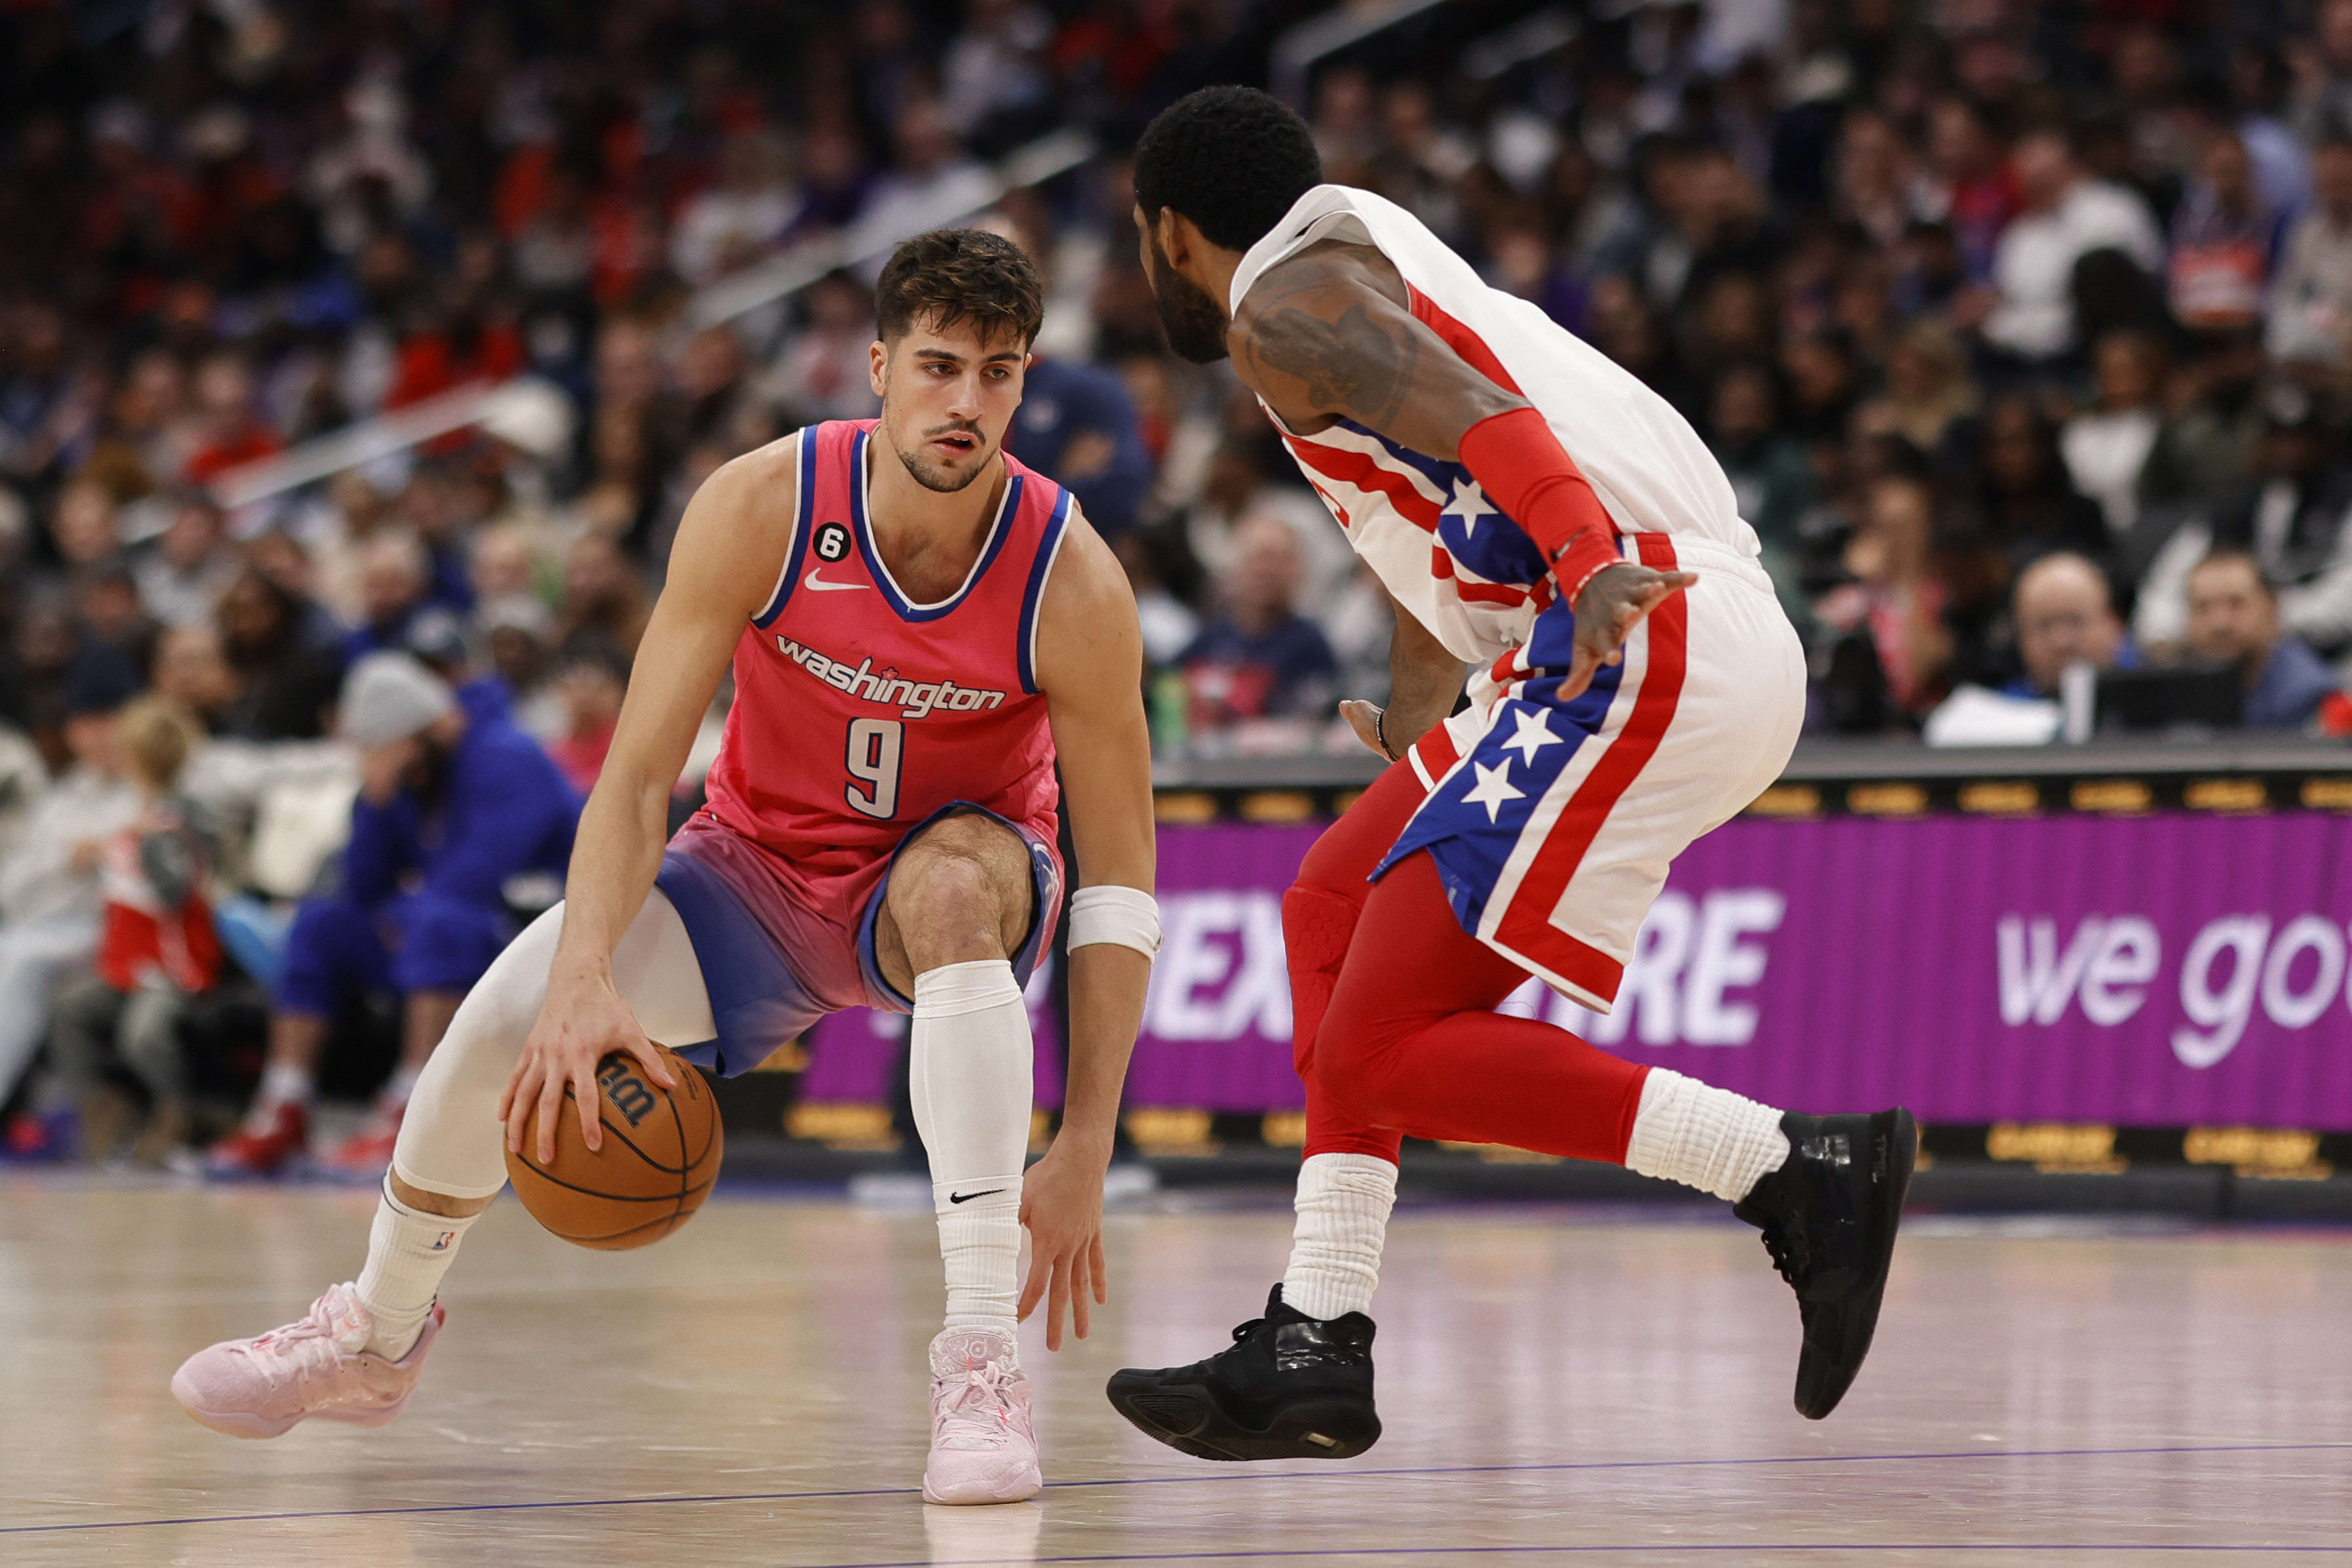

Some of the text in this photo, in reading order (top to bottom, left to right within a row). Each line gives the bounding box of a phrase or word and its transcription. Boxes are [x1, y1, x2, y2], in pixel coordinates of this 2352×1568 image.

[820, 528, 843, 558] 6
[776, 634, 1006, 719] washington
[844, 717, 905, 821] 9
[1996, 910, 2352, 1070] we go
